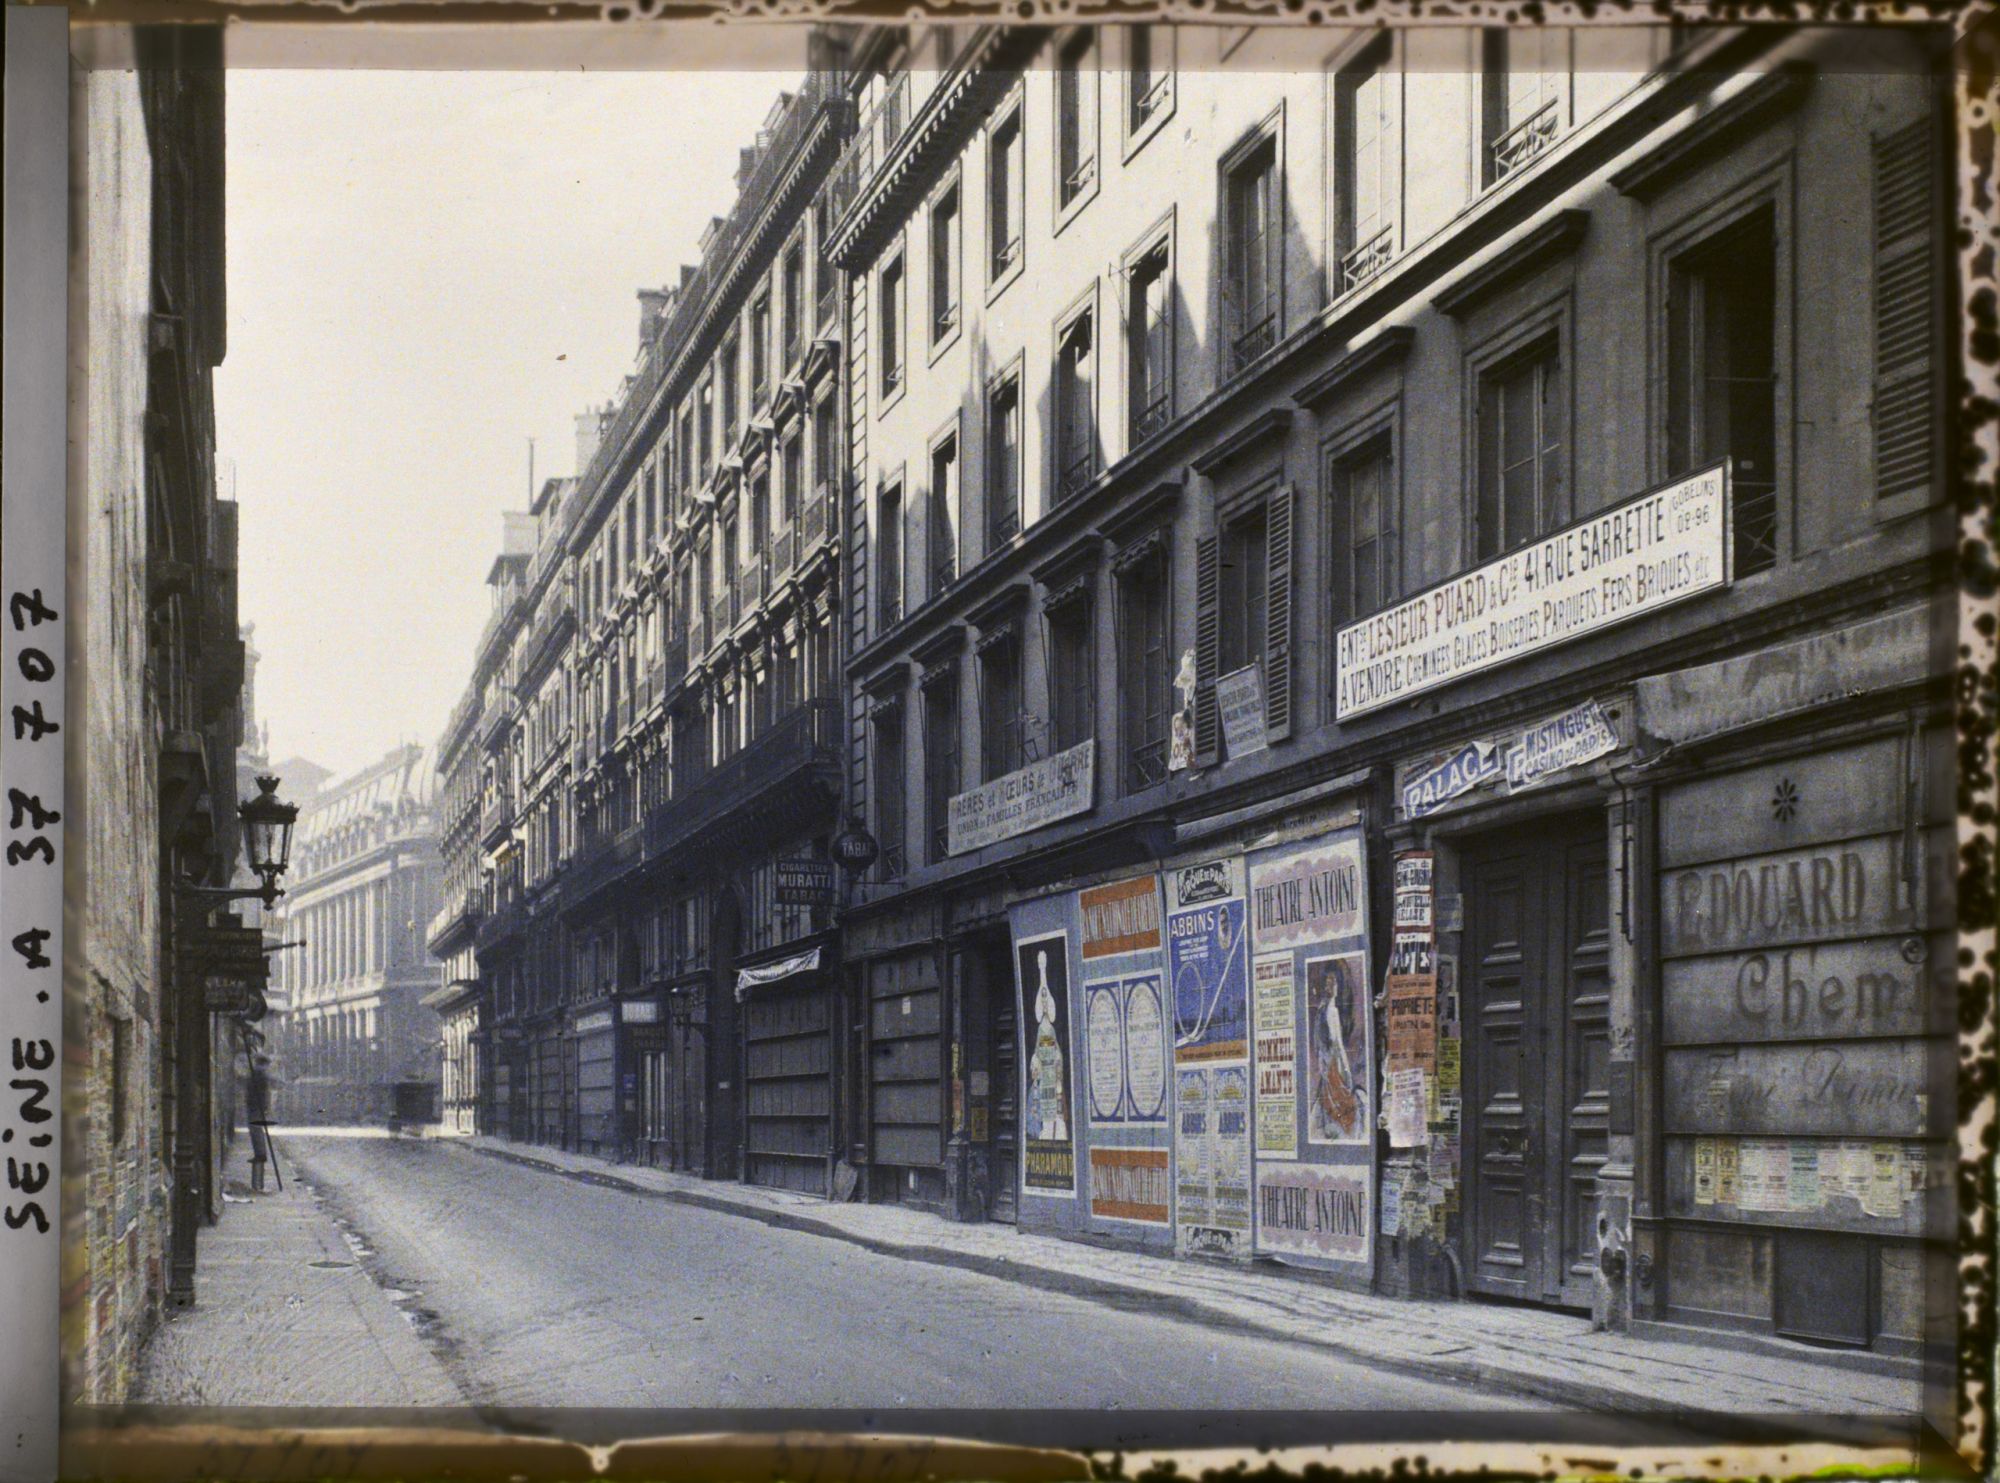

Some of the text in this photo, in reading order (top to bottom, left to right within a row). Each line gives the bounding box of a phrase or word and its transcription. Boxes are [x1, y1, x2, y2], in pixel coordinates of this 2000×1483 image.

[1671, 480, 1715, 511] GOBELINS
[1368, 598, 1428, 659] LESIEUR
[1434, 574, 1486, 633] PUARD
[1545, 534, 1574, 586] RUE
[1580, 497, 1665, 572] SARRETTE
[1340, 676, 1349, 711] A
[1602, 574, 1632, 616] FERS
[1637, 551, 1691, 604] BRIQUES
[1408, 752, 1494, 813] PALACE
[777, 873, 831, 889] MURATTI
[784, 889, 825, 904] TABAC
[1254, 878, 1304, 931] THEATRE
[1308, 865, 1358, 920] ANTOINE
[1675, 853, 1866, 948] EDOUARD
[1170, 910, 1215, 938] ABBINS
[1025, 1152, 1073, 1177] PHARAMOND
[1260, 1184, 1309, 1232] THEATRE
[1314, 1189, 1365, 1238] ANTOINE
